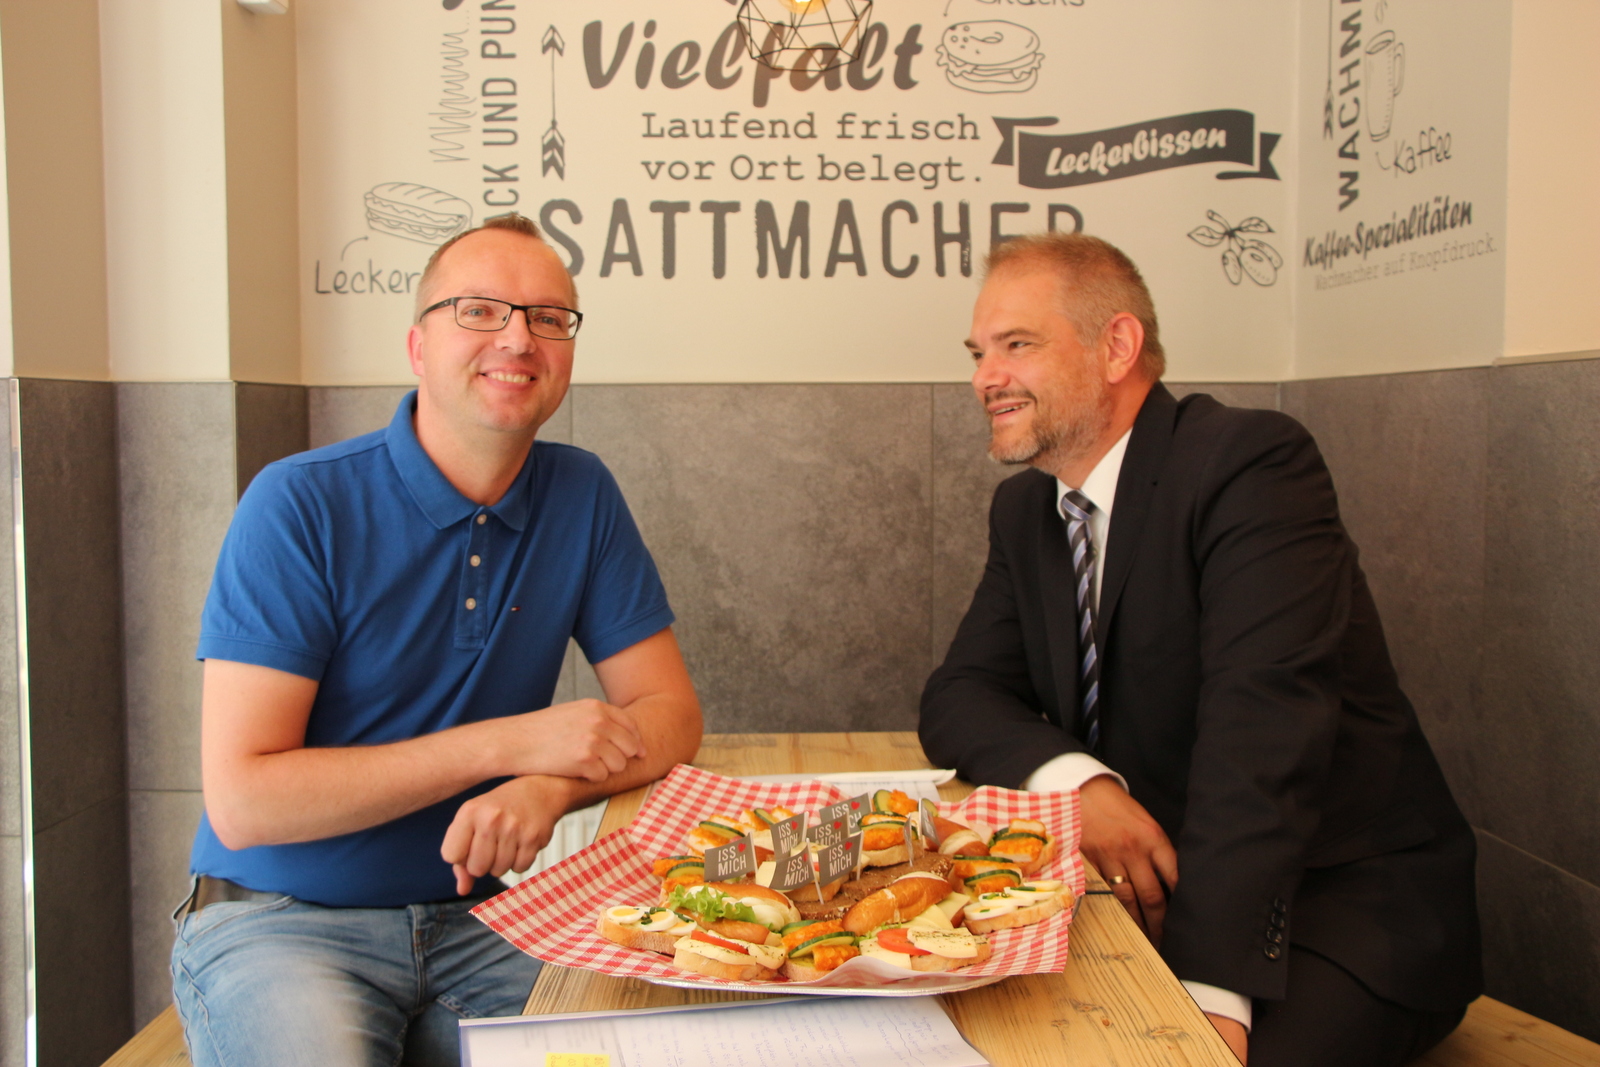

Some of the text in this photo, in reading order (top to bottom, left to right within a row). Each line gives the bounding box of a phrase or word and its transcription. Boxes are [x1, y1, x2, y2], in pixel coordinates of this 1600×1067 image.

[583, 20, 923, 108] Vielfalt
[482, 78, 518, 146] UND
[1338, 0, 1362, 212] WACHM
[641, 112, 981, 140] Laufend frisch
[1045, 127, 1227, 177] Leckerbissen
[1393, 126, 1452, 178] Kaffee
[640, 154, 982, 190] vor Ort belegt.
[483, 164, 519, 219] CK
[1303, 195, 1472, 270] Kaffee-Spezialitäten
[1383, 253, 1406, 277] auf
[1408, 231, 1498, 272] Knopfdruck.
[314, 259, 421, 295] Lecker
[778, 822, 792, 839] ISS
[780, 833, 799, 854] MICH
[815, 824, 832, 839] ISS
[718, 845, 736, 862] ISS
[718, 854, 747, 877] MICH
[787, 856, 803, 873] ISS
[829, 844, 843, 862] ISS
[829, 852, 852, 877] MICH
[784, 864, 810, 886] MICH
